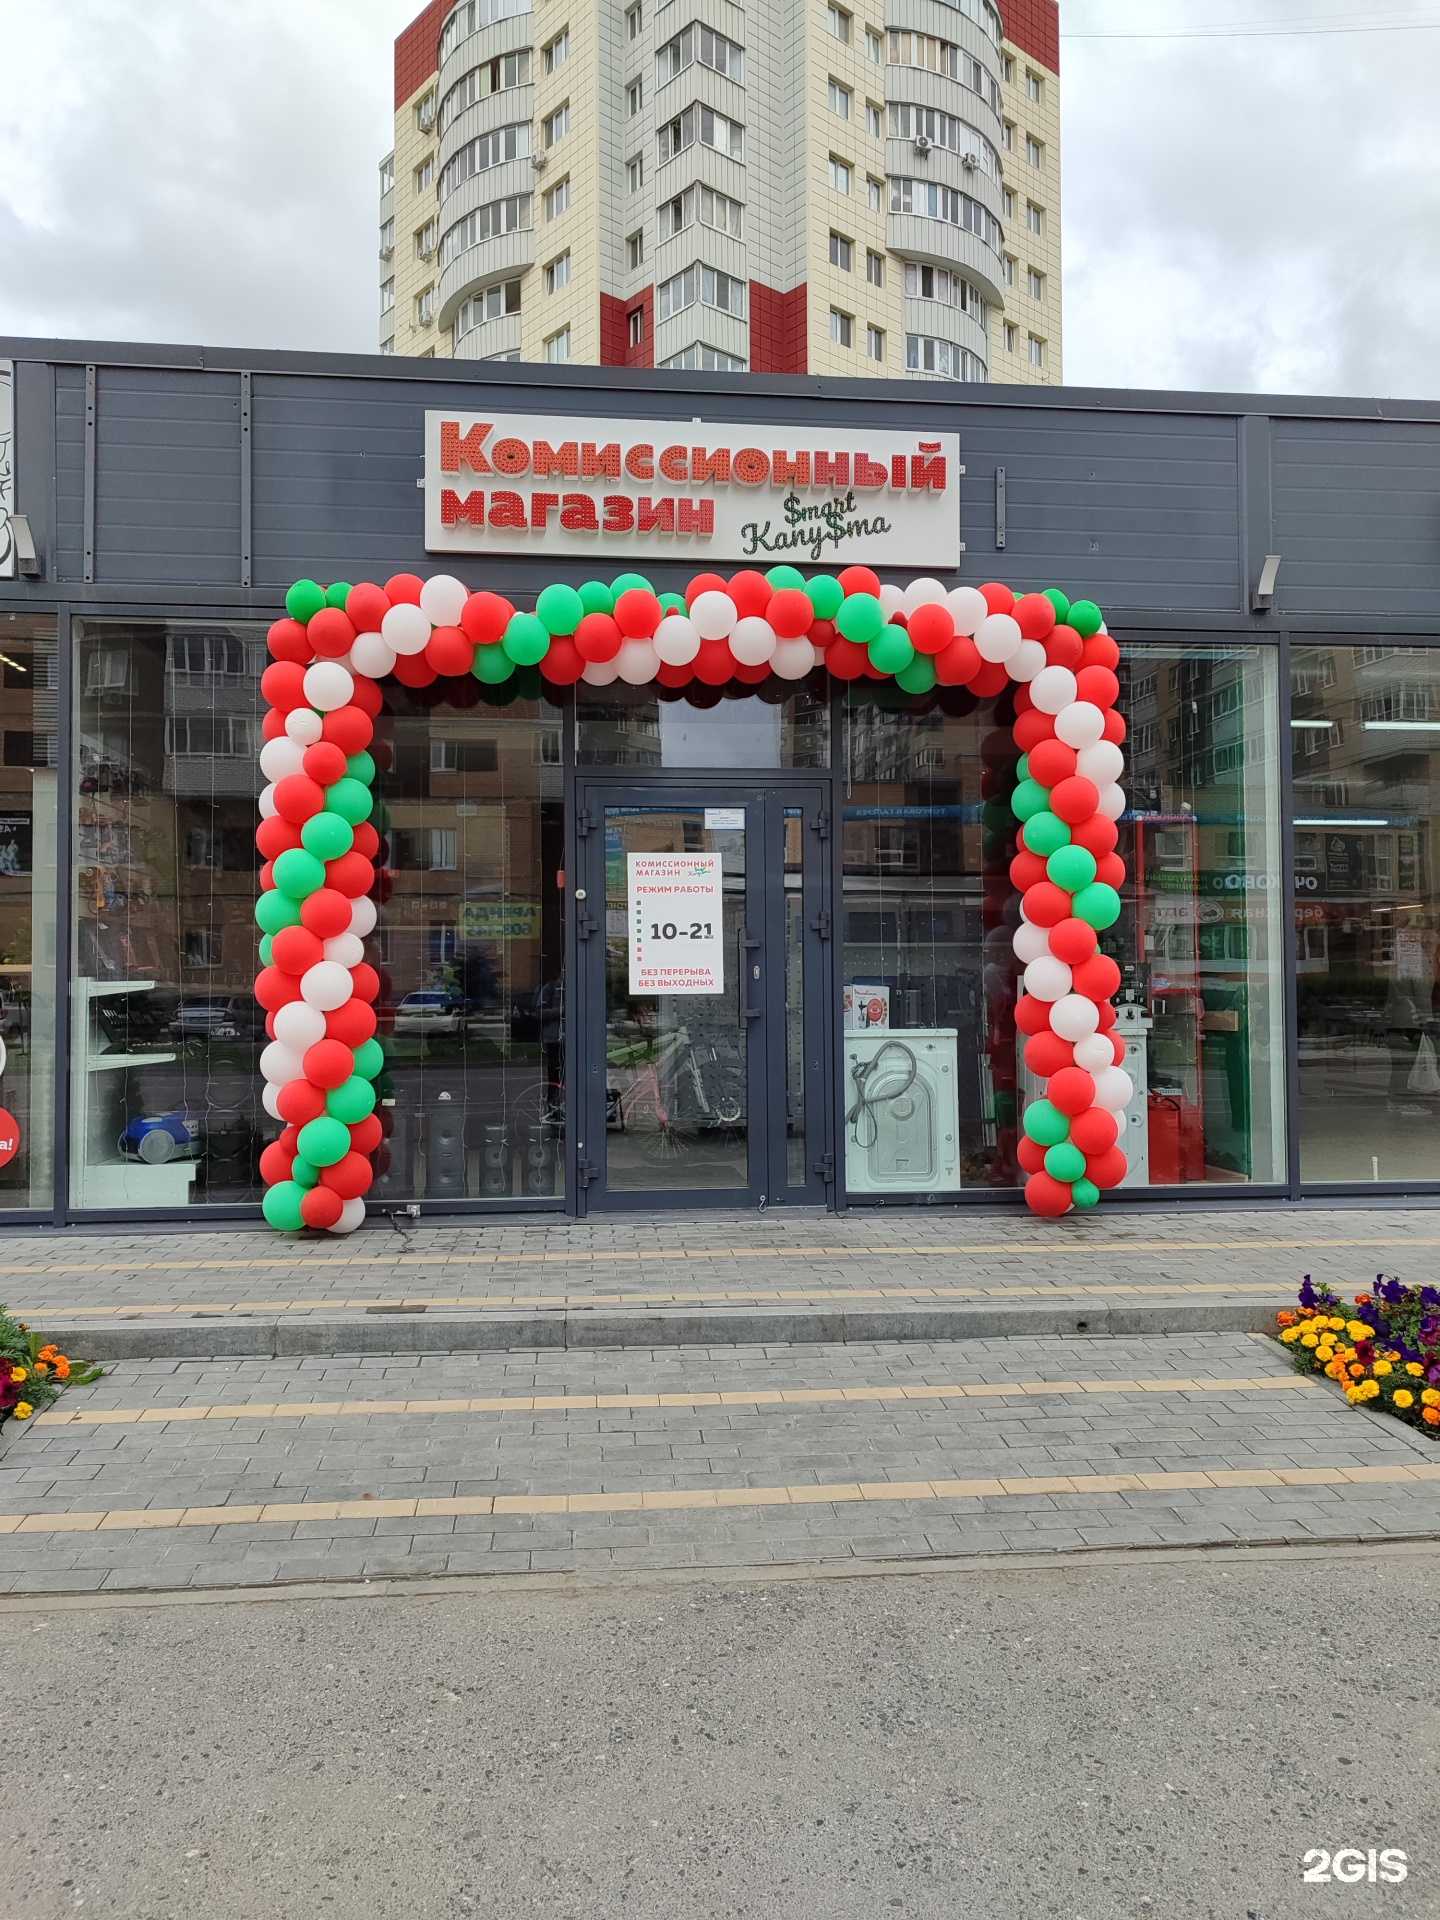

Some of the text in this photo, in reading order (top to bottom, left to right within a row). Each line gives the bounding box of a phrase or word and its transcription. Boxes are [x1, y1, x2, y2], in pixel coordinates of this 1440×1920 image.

[441, 421, 947, 492] Комиссионный
[440, 489, 715, 536] магазин
[635, 859, 714, 868] КОМИССИОННЫЙ
[635, 869, 680, 877] МАГАЗИН
[636, 885, 714, 894] РЕЖИМ РАБОТЫ
[650, 922, 714, 940] 10-21
[641, 968, 711, 976] БЕЗ ПЕРЕРЫВА
[638, 978, 714, 987] БЕЗ ВЫХОДНЫХ
